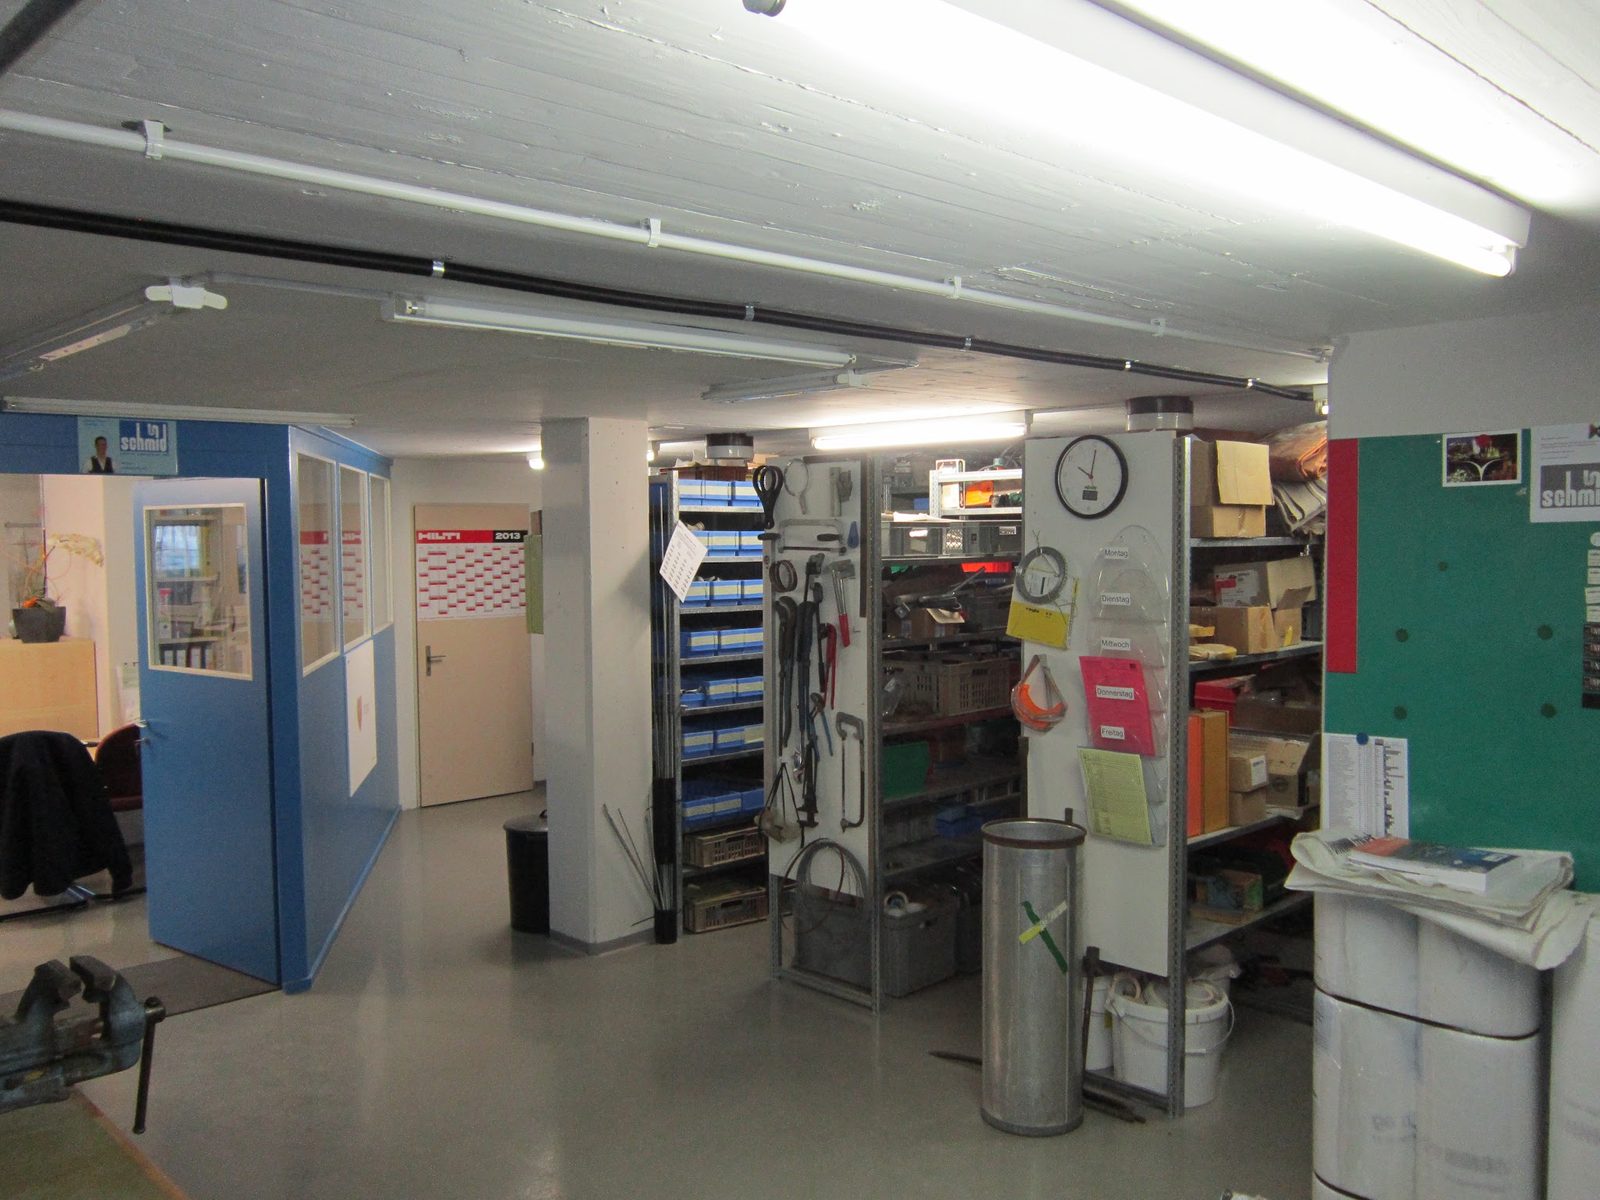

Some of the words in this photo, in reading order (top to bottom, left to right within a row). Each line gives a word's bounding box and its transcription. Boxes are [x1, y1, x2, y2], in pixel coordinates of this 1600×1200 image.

[121, 423, 167, 452] schmid
[418, 532, 461, 540] HILTI
[495, 532, 521, 540] 2013
[1104, 549, 1128, 558] Montag
[1102, 595, 1130, 604] Dienstag
[1101, 640, 1130, 648] Mittwoch
[1097, 687, 1133, 699] Donnerstag
[1102, 727, 1124, 738] Freitag
